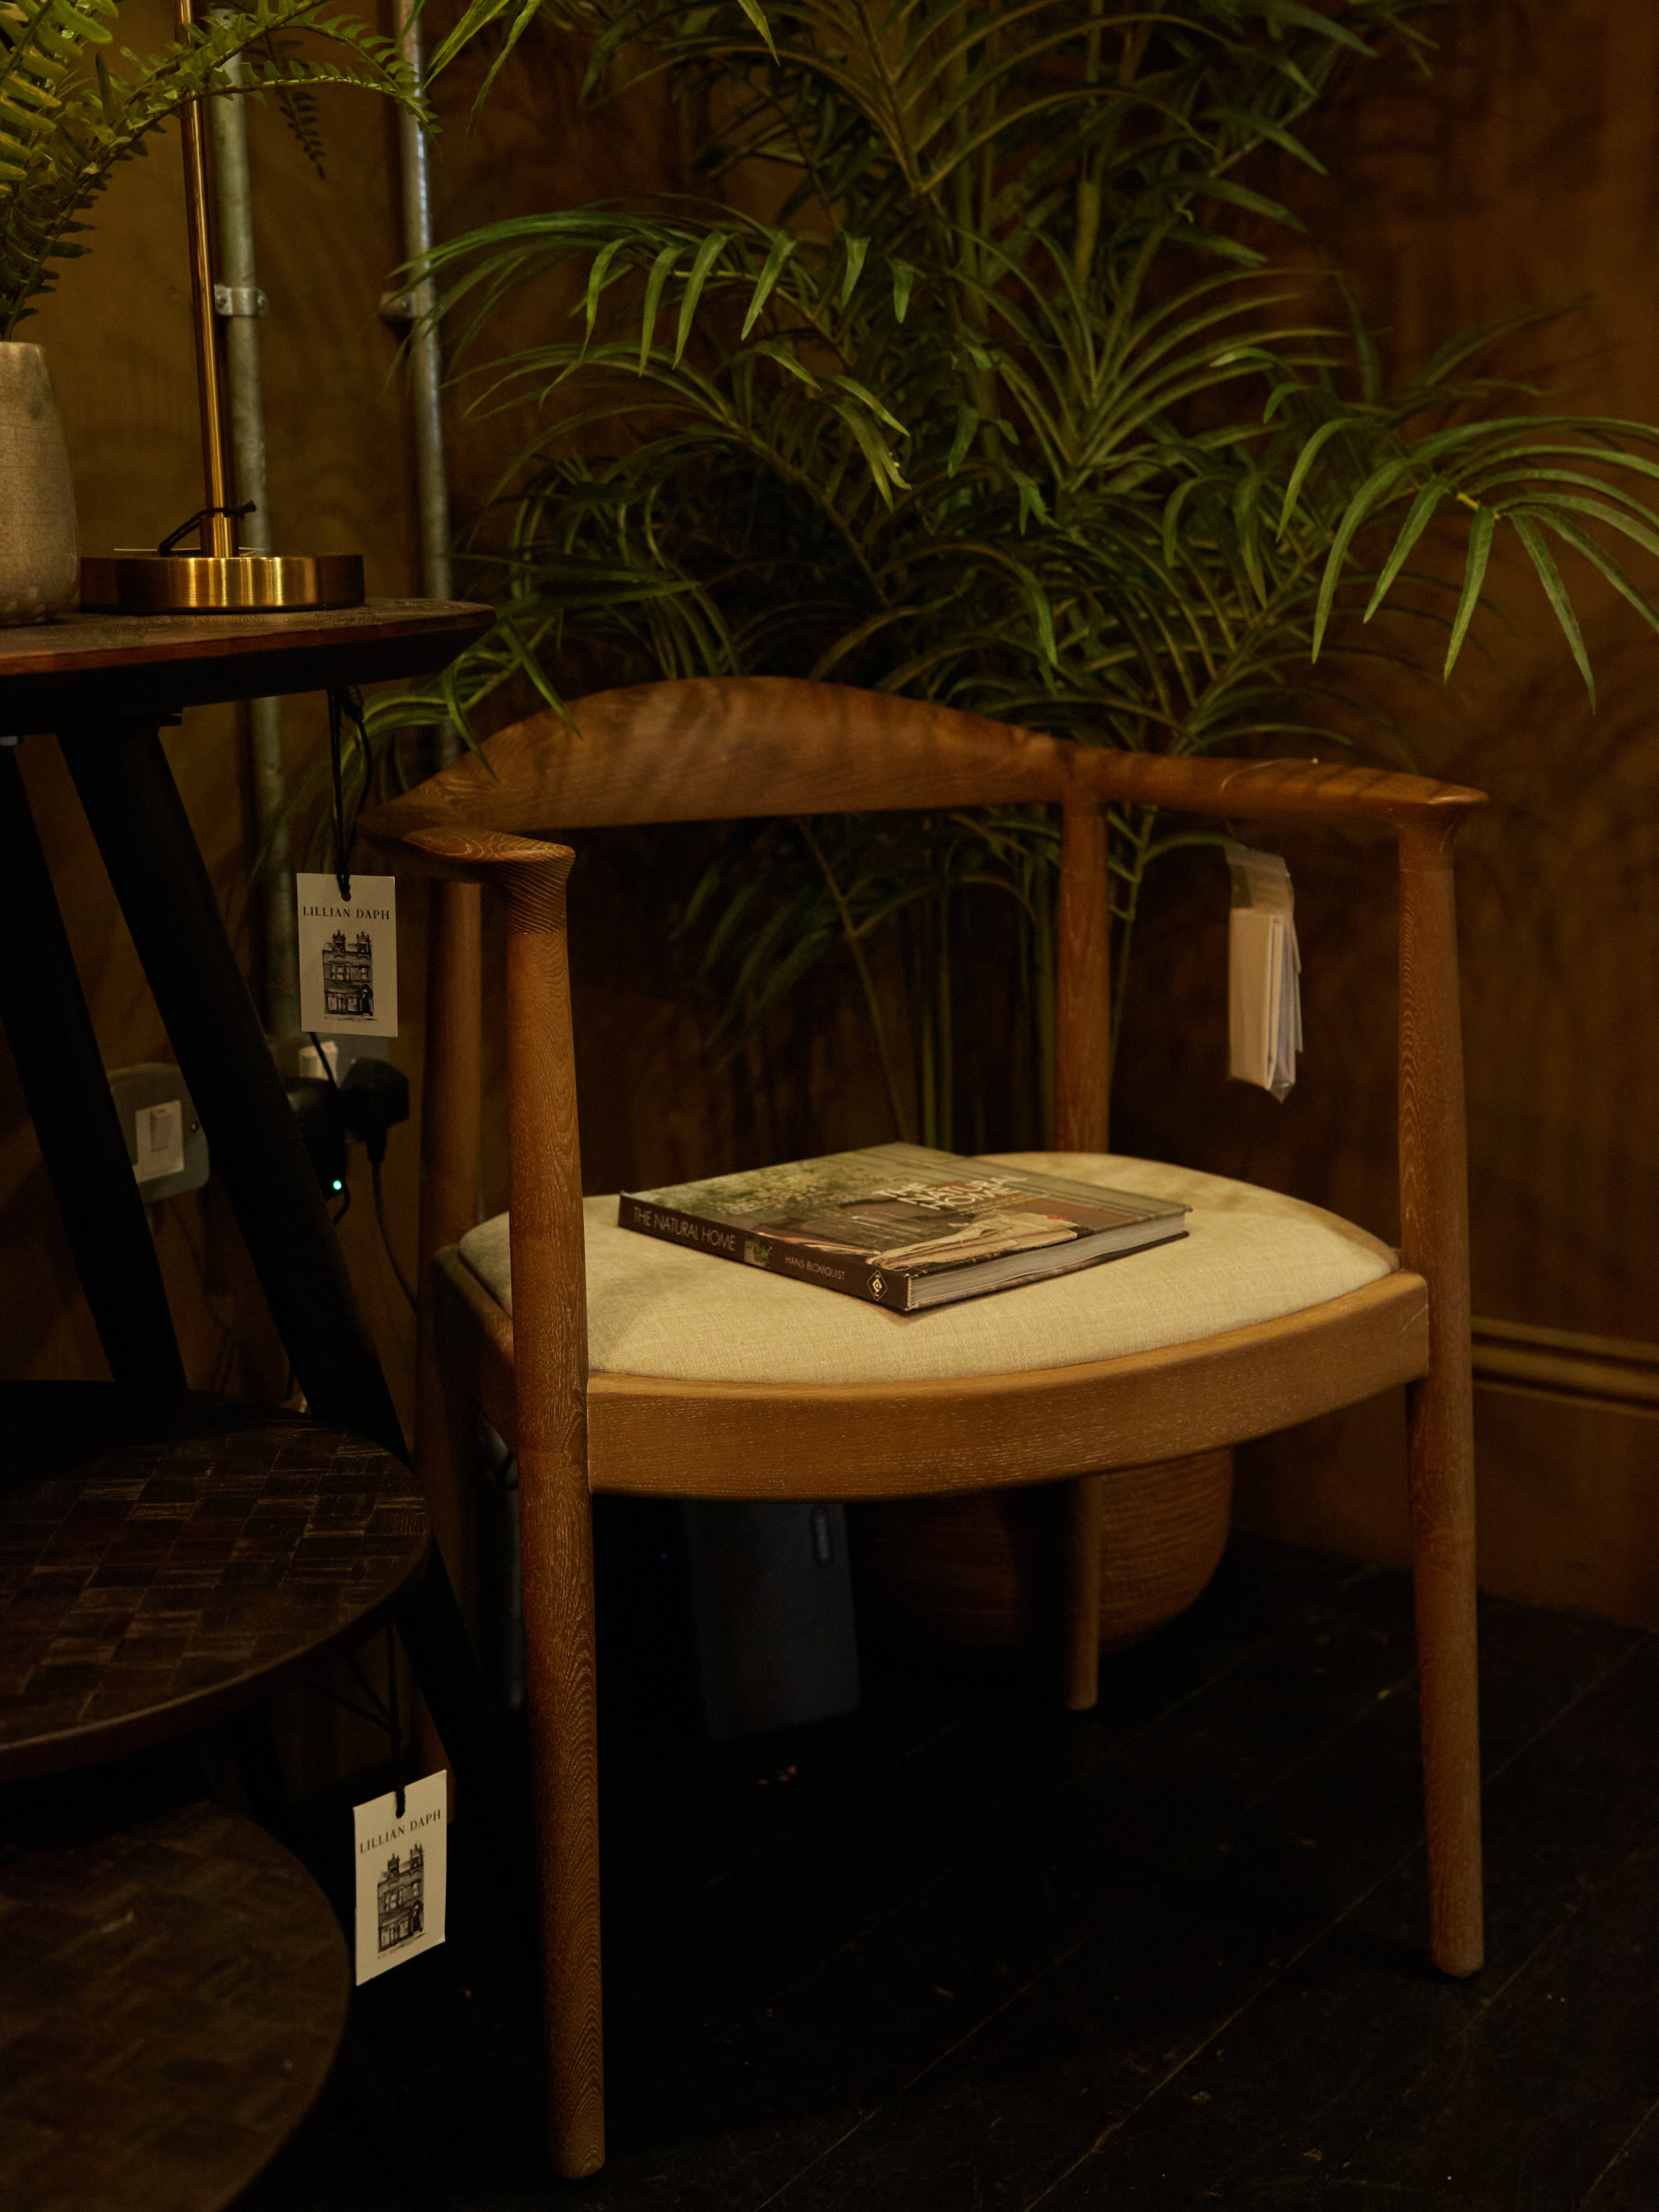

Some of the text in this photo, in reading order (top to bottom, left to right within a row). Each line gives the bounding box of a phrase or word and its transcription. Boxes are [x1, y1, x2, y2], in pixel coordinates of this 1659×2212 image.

[303, 906, 389, 919] LILLIAN DAPH
[634, 1206, 735, 1251] THE NATURAL HOME
[785, 1256, 845, 1280] HANS BLOMQUIST
[360, 1809, 441, 1853] LILLIAN DAPH
